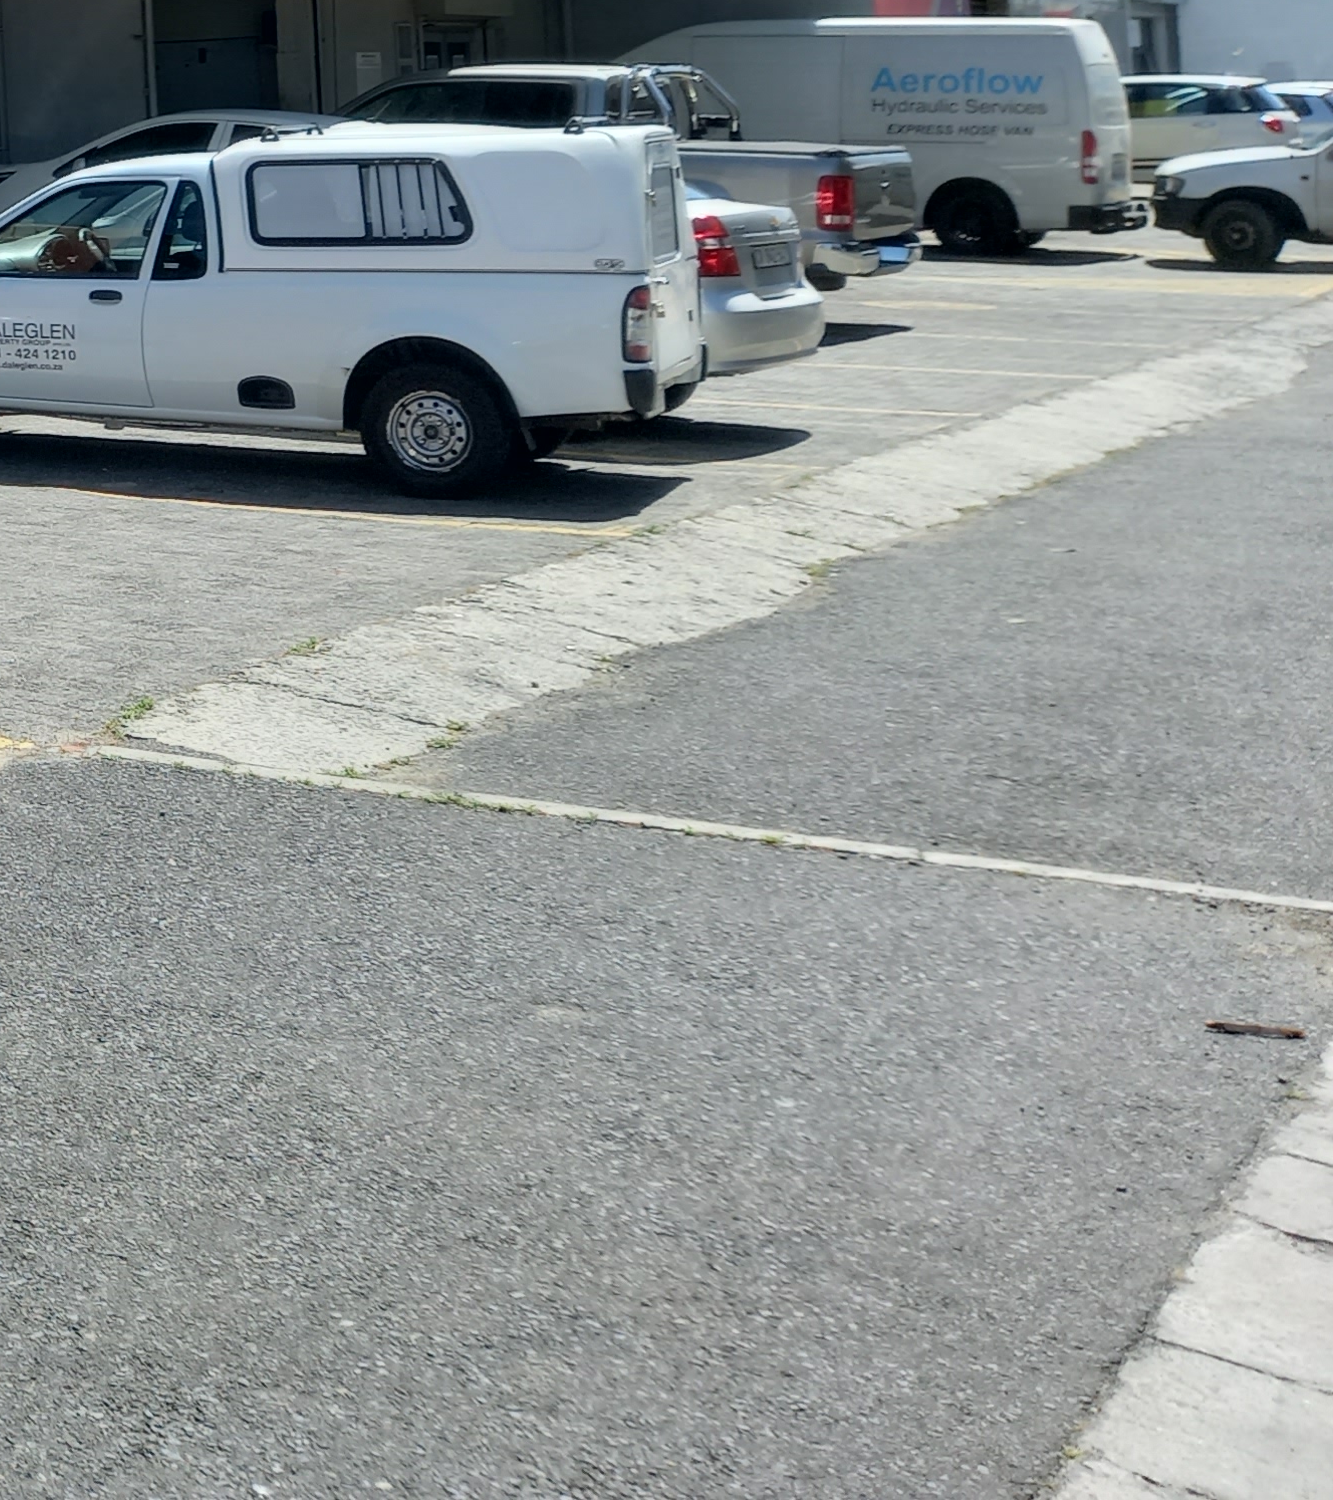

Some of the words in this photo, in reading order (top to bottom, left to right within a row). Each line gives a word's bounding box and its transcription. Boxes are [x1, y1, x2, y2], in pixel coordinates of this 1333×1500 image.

[871, 66, 1044, 94] Aeroflow
[872, 99, 959, 117] Hydraulic
[965, 99, 1049, 115] Services
[886, 123, 954, 135] EXPRESS
[22, 338, 51, 346] GROUP
[15, 348, 39, 359] 424
[44, 349, 77, 361] 1210
